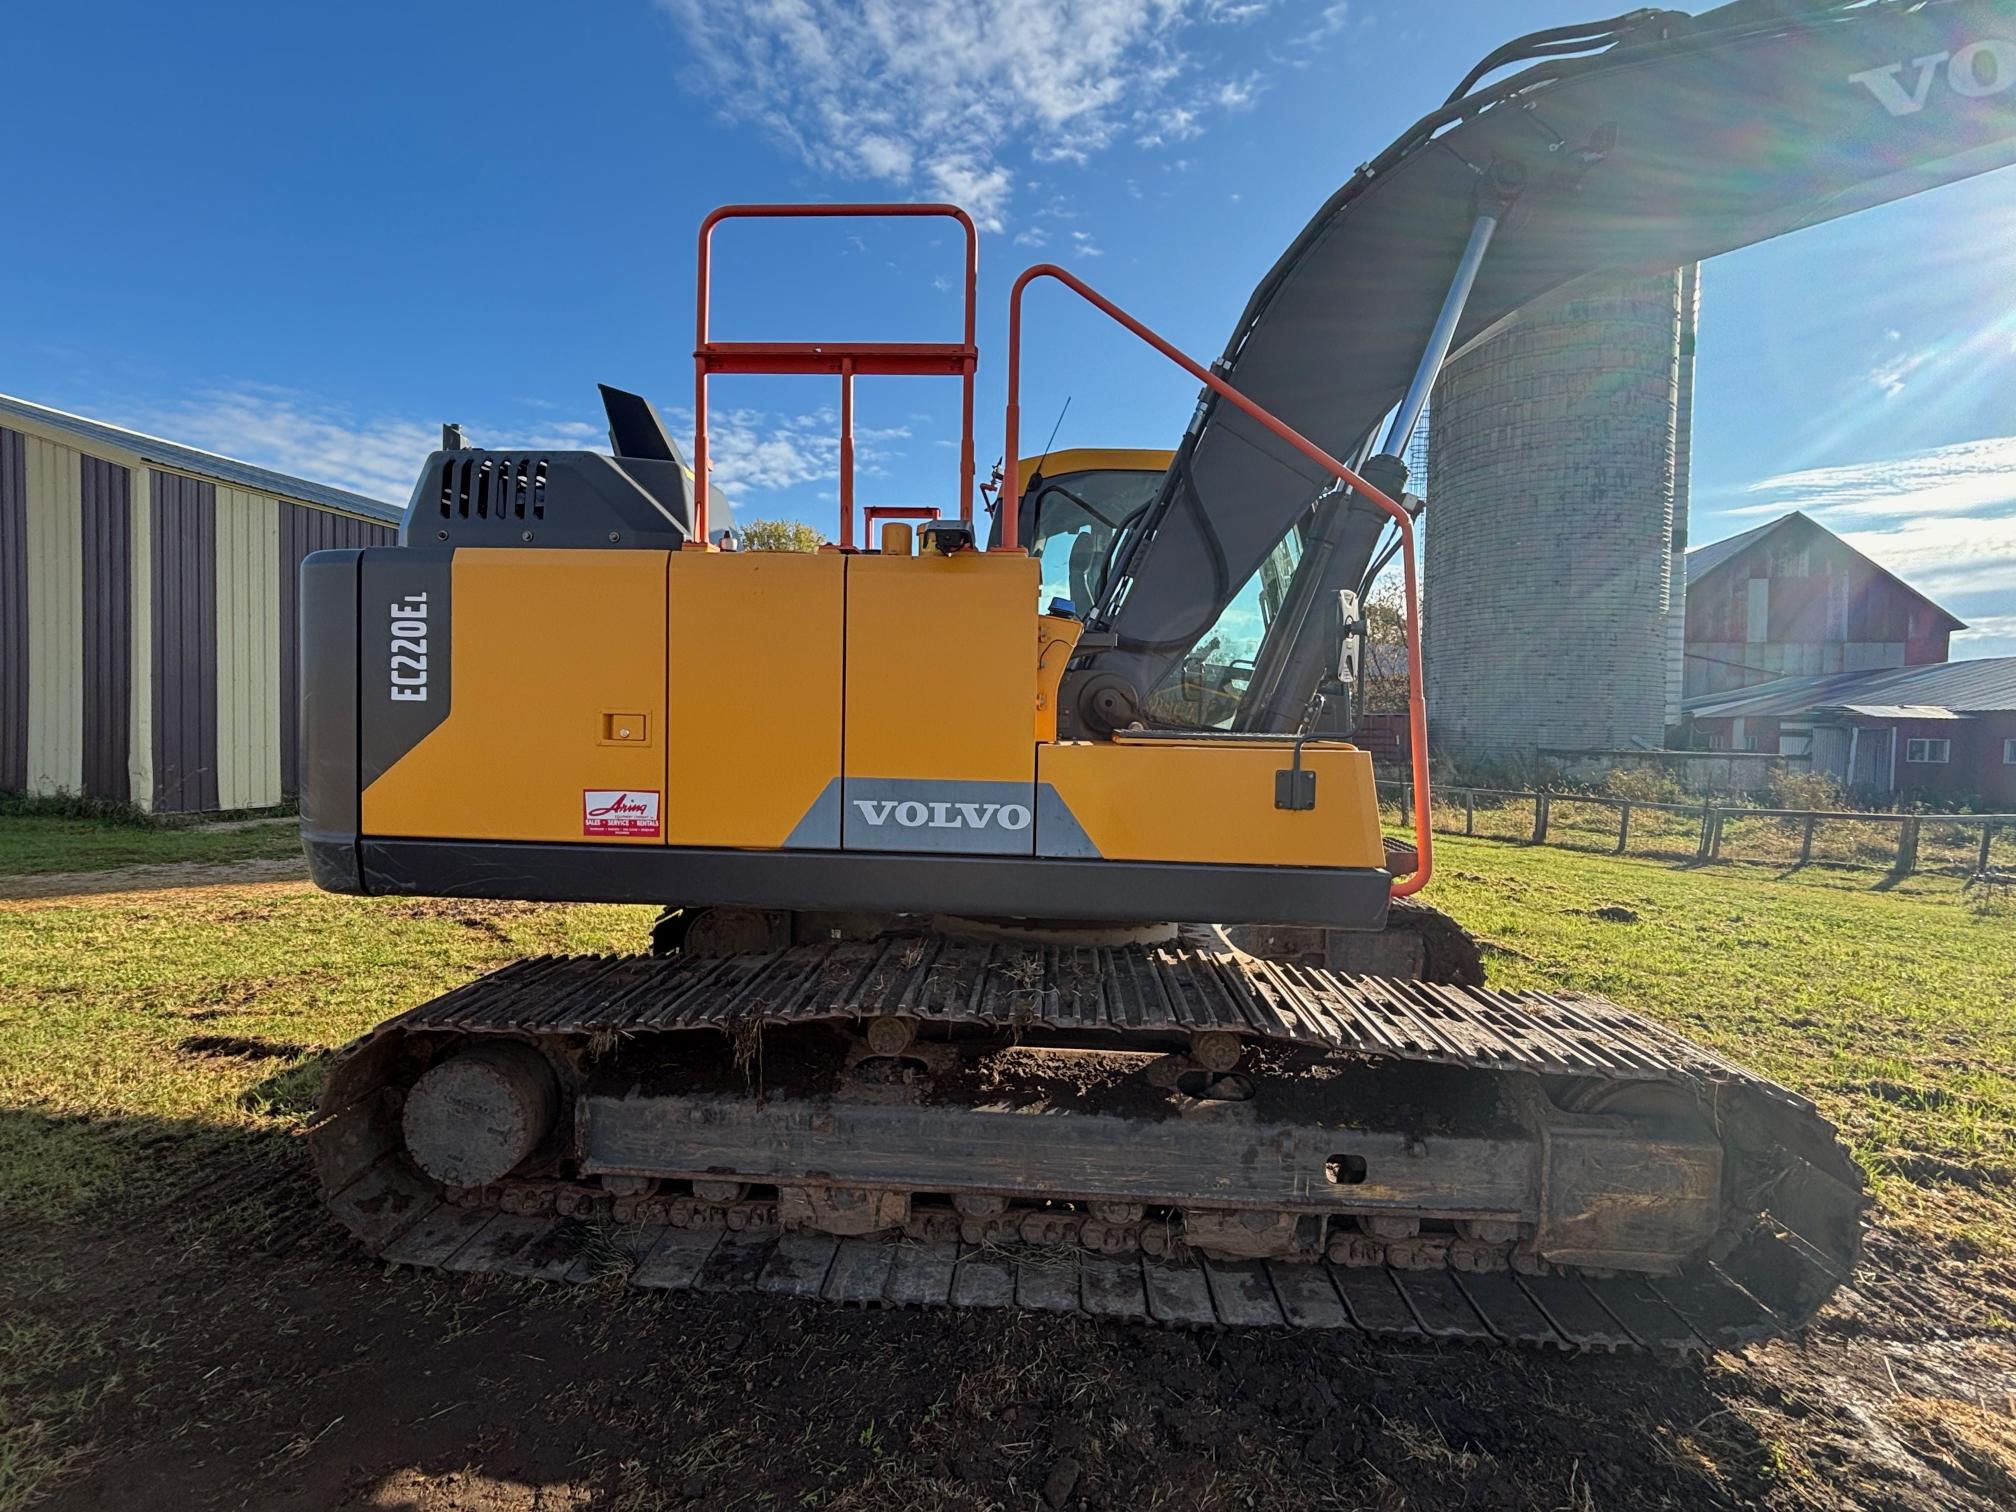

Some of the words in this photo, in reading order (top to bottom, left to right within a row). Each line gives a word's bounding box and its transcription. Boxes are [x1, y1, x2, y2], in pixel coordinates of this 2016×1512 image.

[391, 592, 427, 701] EC220EL
[589, 794, 647, 816] Aring
[853, 800, 1031, 830] VOLVO
